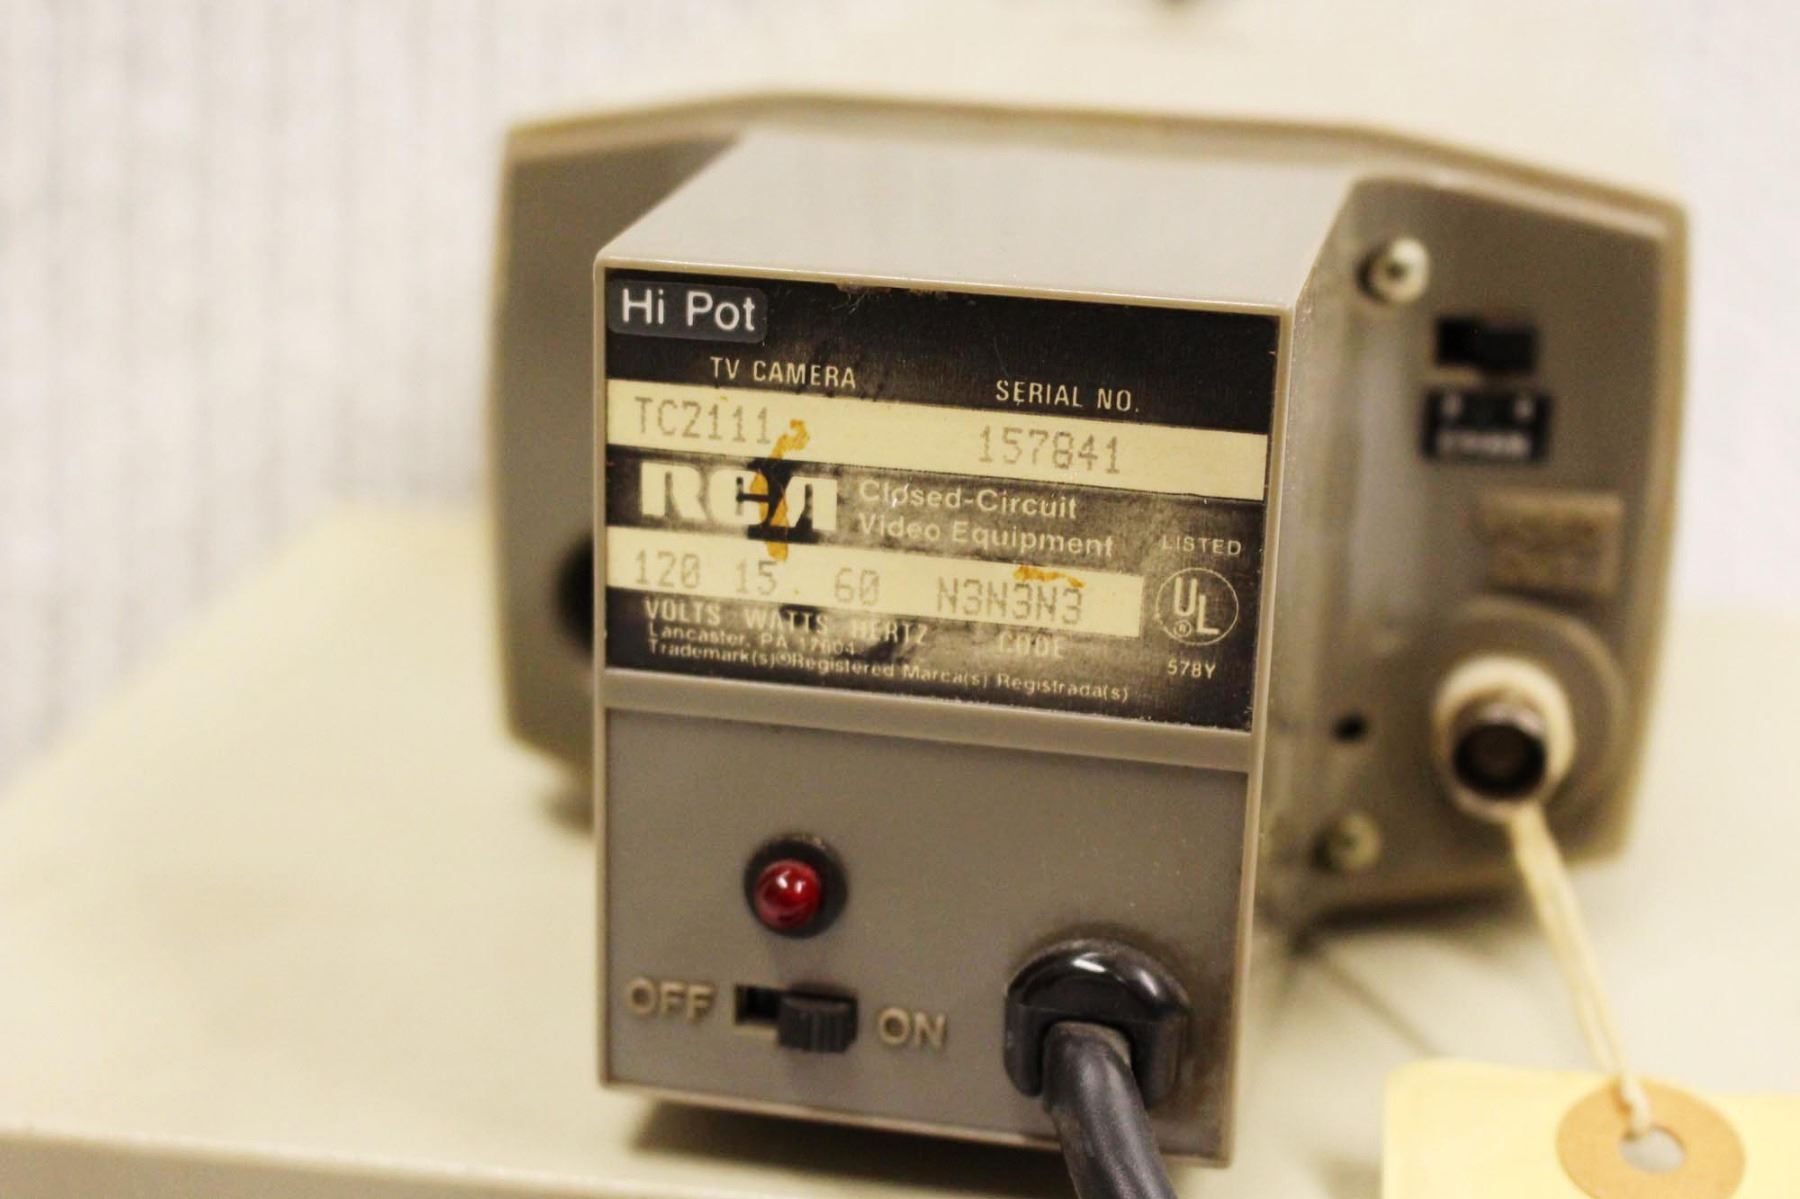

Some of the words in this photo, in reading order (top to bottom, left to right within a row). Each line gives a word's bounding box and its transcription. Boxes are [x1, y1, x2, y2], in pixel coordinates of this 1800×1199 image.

[622, 288, 664, 325] Hi
[686, 290, 755, 331] Pot
[710, 356, 740, 380] TV
[753, 360, 857, 388] CAMERA
[995, 379, 1083, 408] SERIAL
[1097, 388, 1139, 413] NO.
[635, 396, 770, 445] TC2111
[978, 425, 1120, 474] 157841
[641, 462, 838, 530] RCA
[858, 479, 1078, 519] Closed-Circuit
[858, 512, 941, 542] Video
[953, 520, 1114, 558] Equipment
[1160, 534, 1242, 556] LISTED
[635, 550, 700, 589] 120
[833, 567, 880, 606] 60
[936, 575, 1083, 625] N3N3N3
[1173, 577, 1220, 635] UL
[646, 600, 722, 627] VOLTS
[743, 607, 829, 636] WATTS
[851, 618, 929, 645] HERTZ
[761, 631, 789, 650] PA
[1168, 658, 1216, 680] 578Y
[631, 977, 716, 1022] OFF
[877, 1006, 947, 1047] ON
